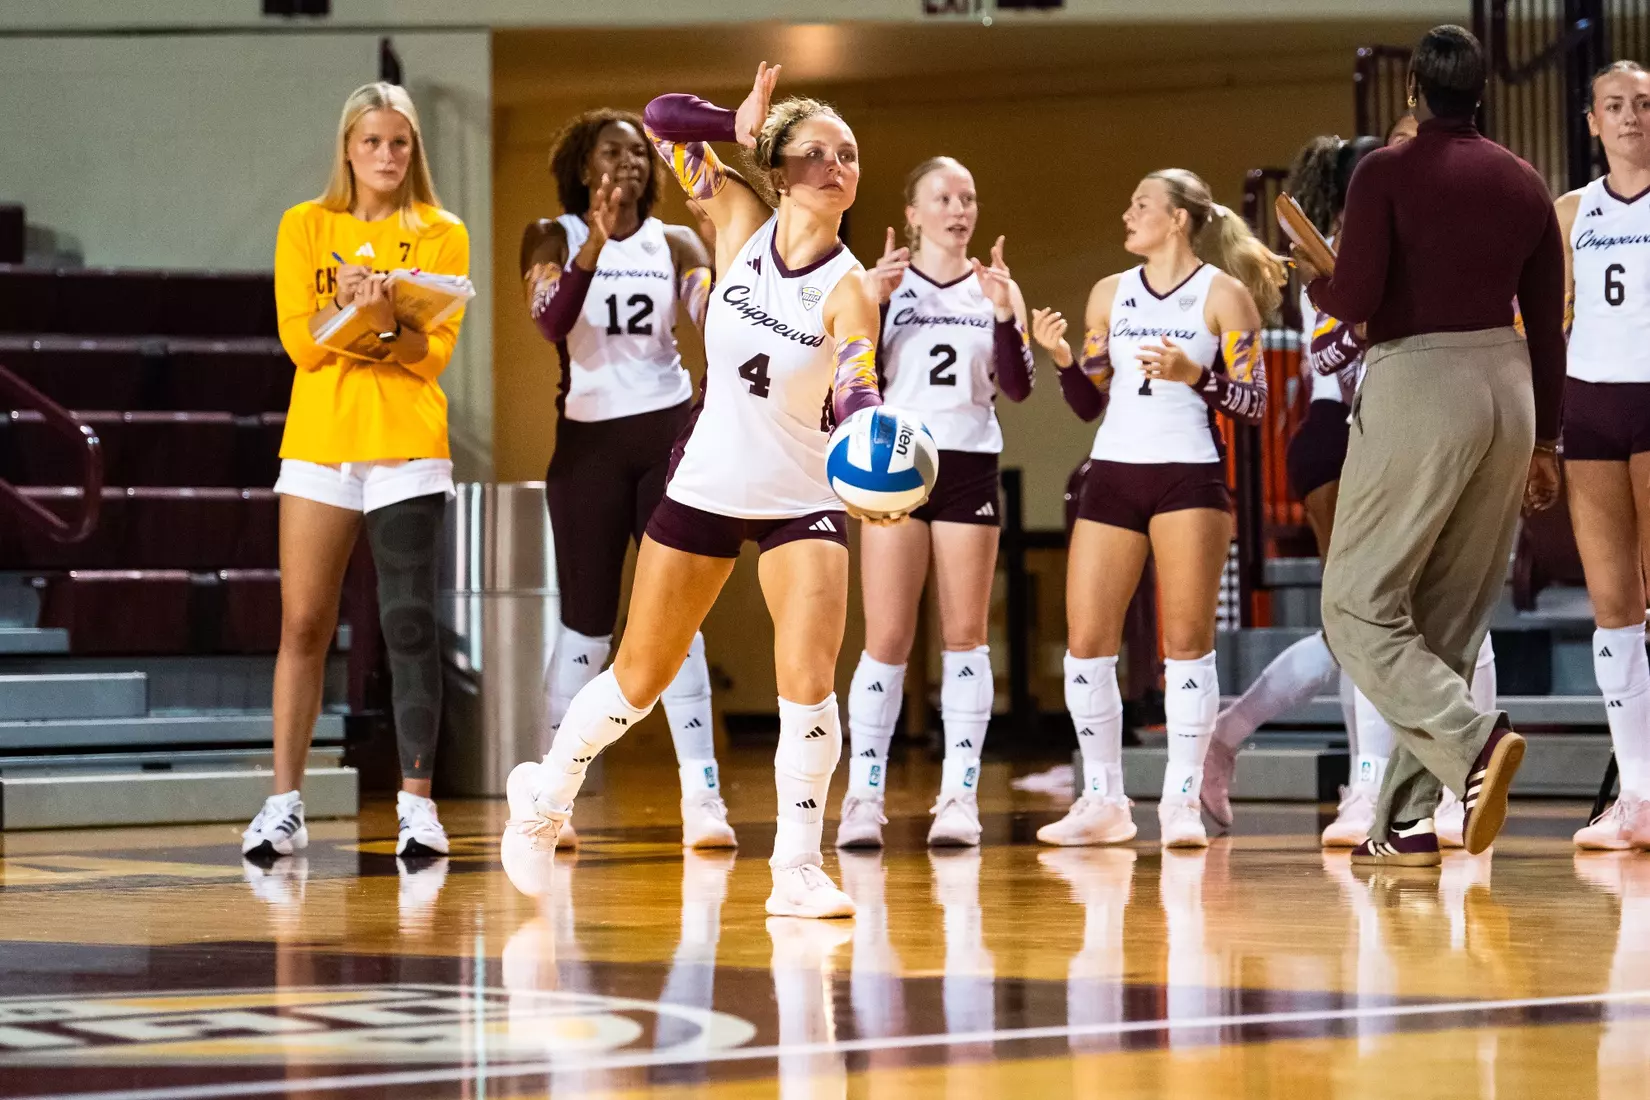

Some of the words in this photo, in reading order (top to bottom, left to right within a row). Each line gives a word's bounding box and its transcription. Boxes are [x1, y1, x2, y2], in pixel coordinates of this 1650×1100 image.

[399, 242, 411, 262] 7
[1605, 263, 1626, 306] 6
[605, 293, 654, 336] 12
[723, 285, 826, 348] Chippewas
[893, 307, 988, 328] Chippewas
[738, 352, 771, 399] 4
[929, 344, 957, 386] 2
[896, 419, 915, 456] lten
